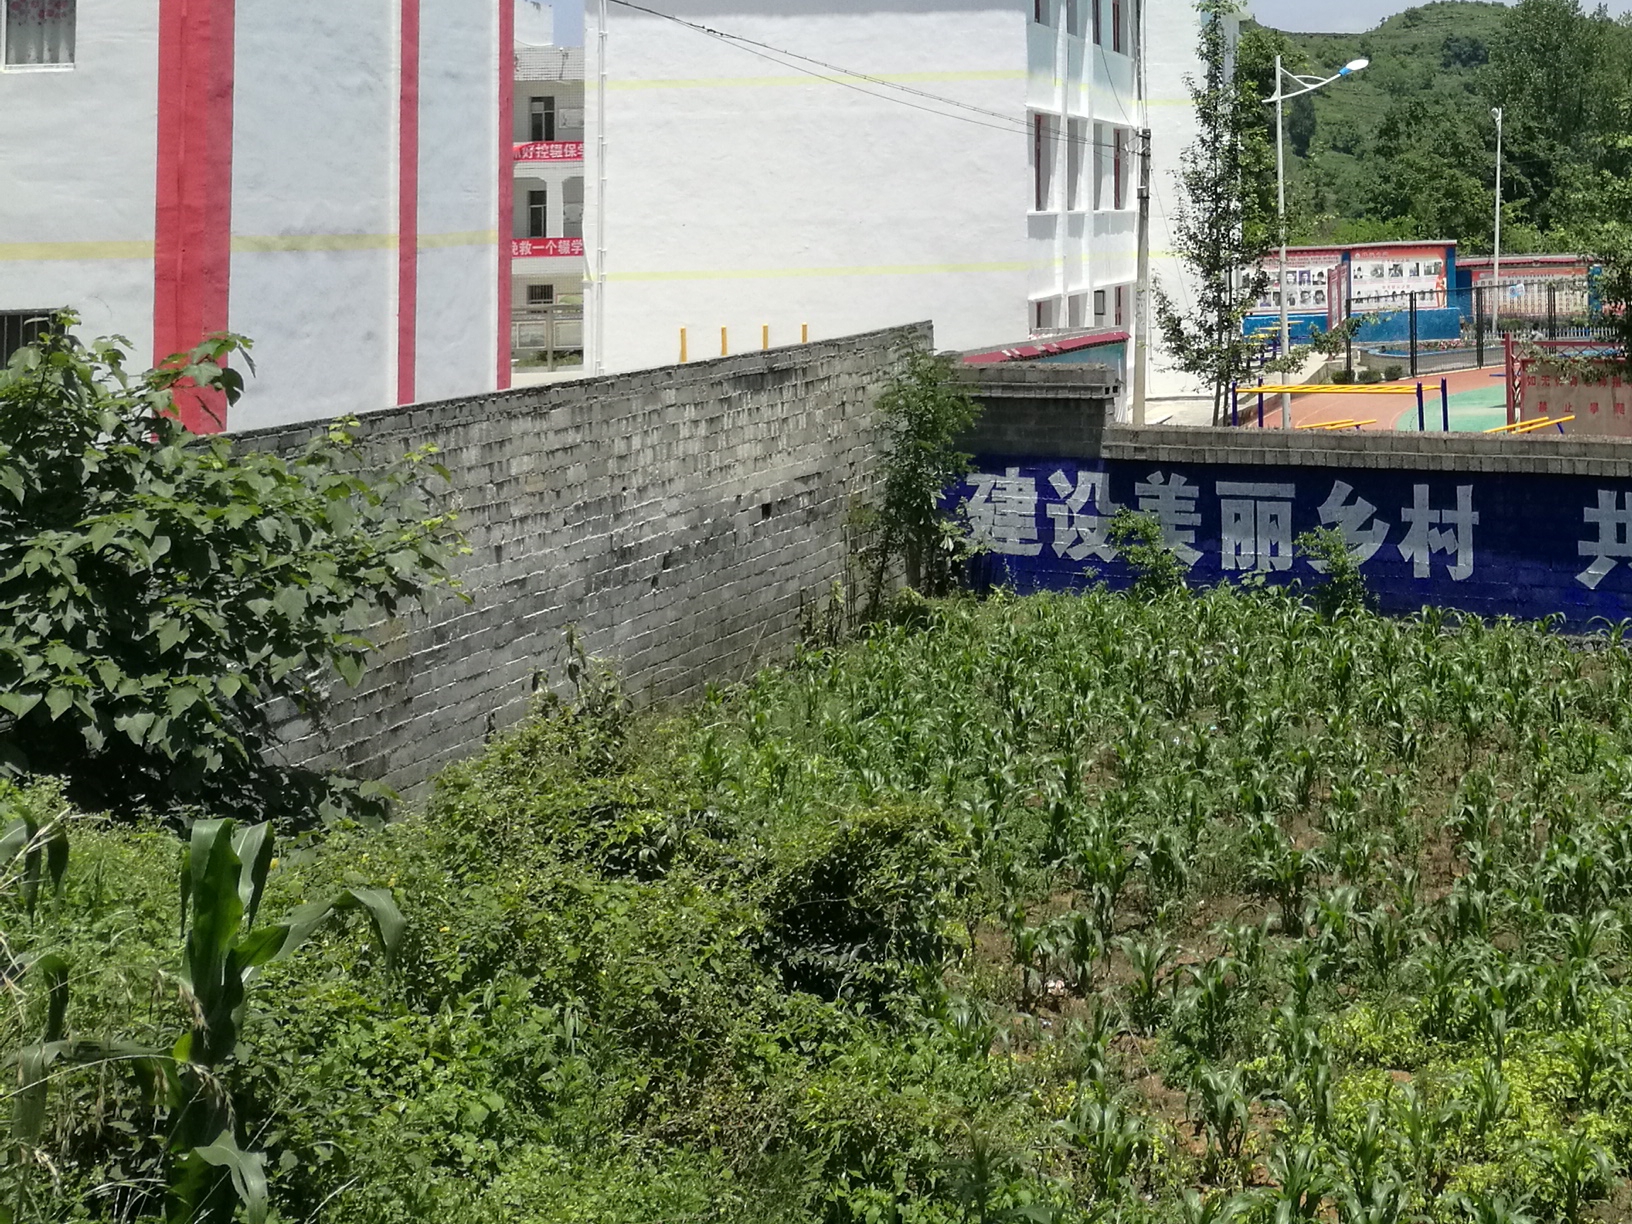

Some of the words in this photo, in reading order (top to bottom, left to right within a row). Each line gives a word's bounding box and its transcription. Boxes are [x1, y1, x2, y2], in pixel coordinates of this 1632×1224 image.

[1537, 401, 1626, 416] 禁止攀爬
[965, 467, 1479, 582] 建设美丽乡村
